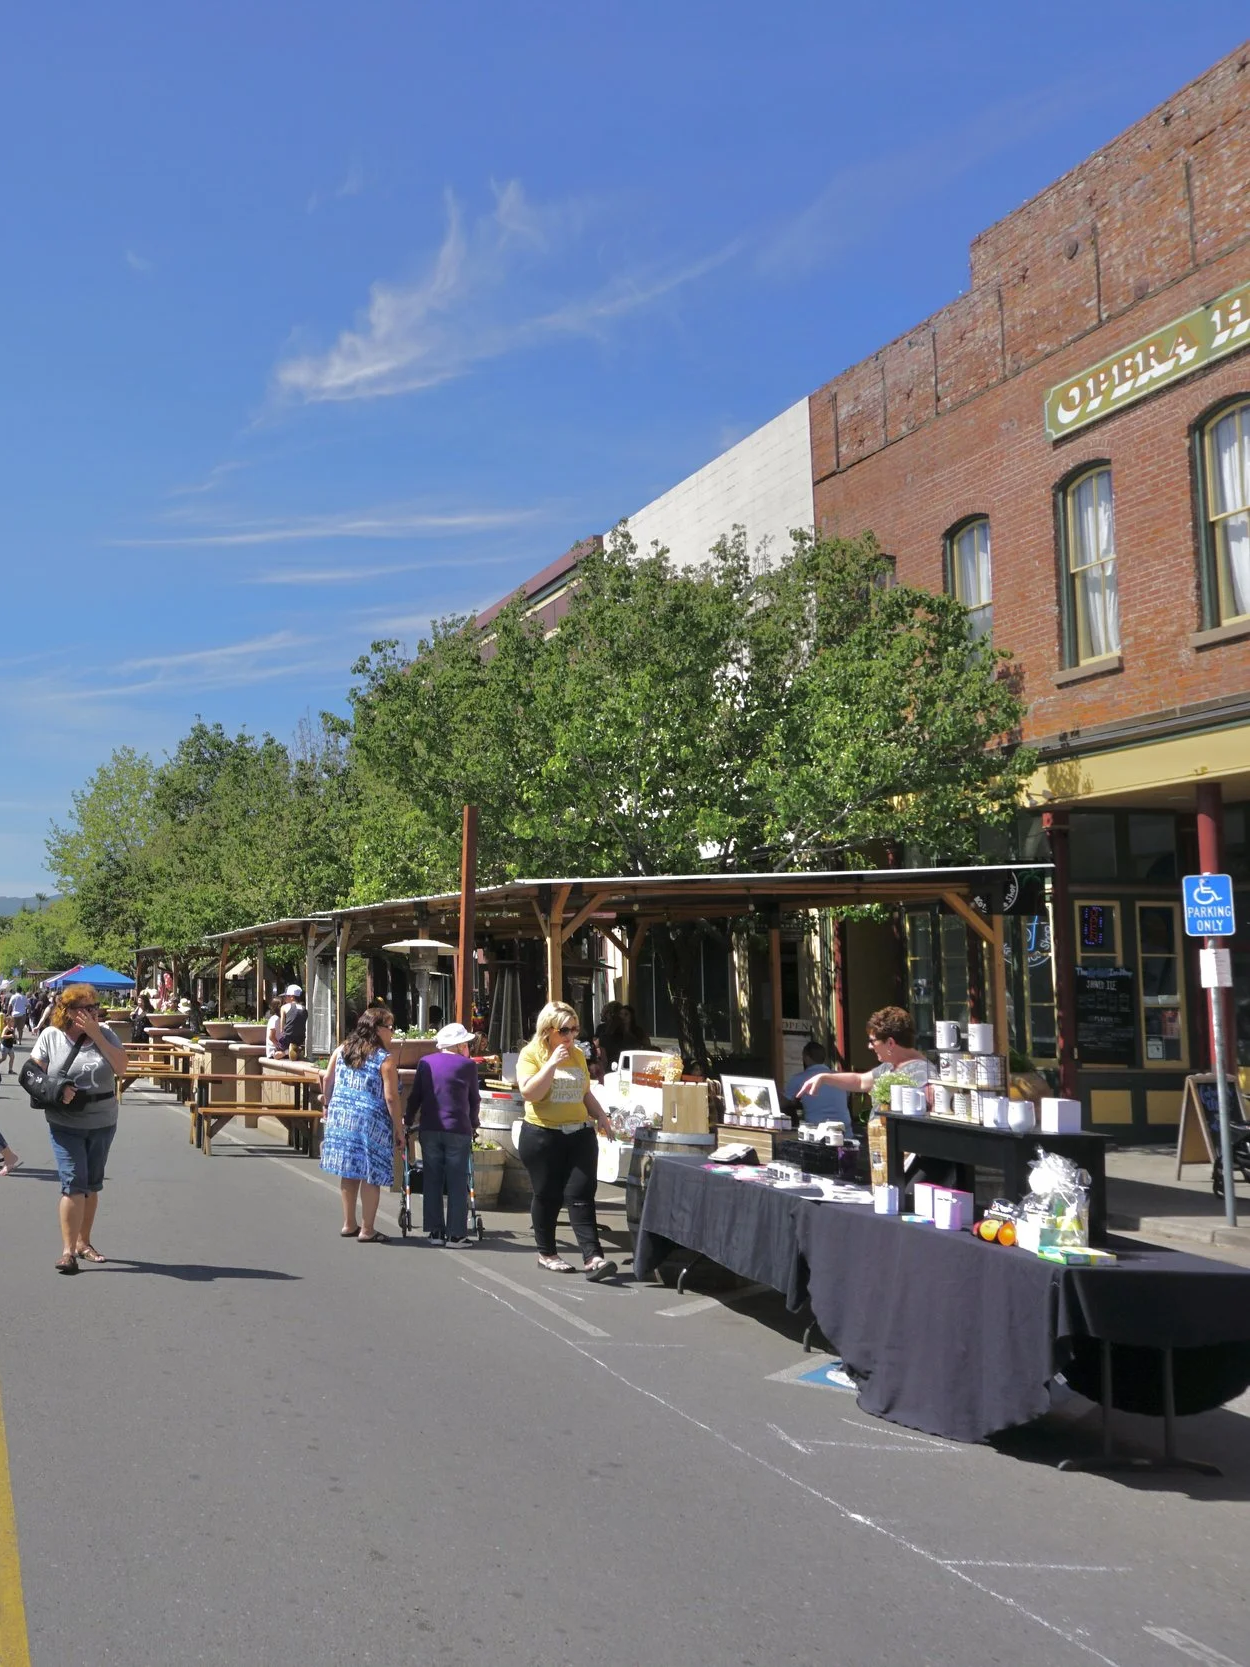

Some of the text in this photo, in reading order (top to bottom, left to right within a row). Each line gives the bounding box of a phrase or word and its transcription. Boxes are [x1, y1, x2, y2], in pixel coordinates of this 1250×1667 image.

[1057, 325, 1200, 424] OPERA
[1187, 905, 1232, 918] PARKING
[1196, 919, 1224, 932] ONLY
[782, 1021, 810, 1031] OPEN
